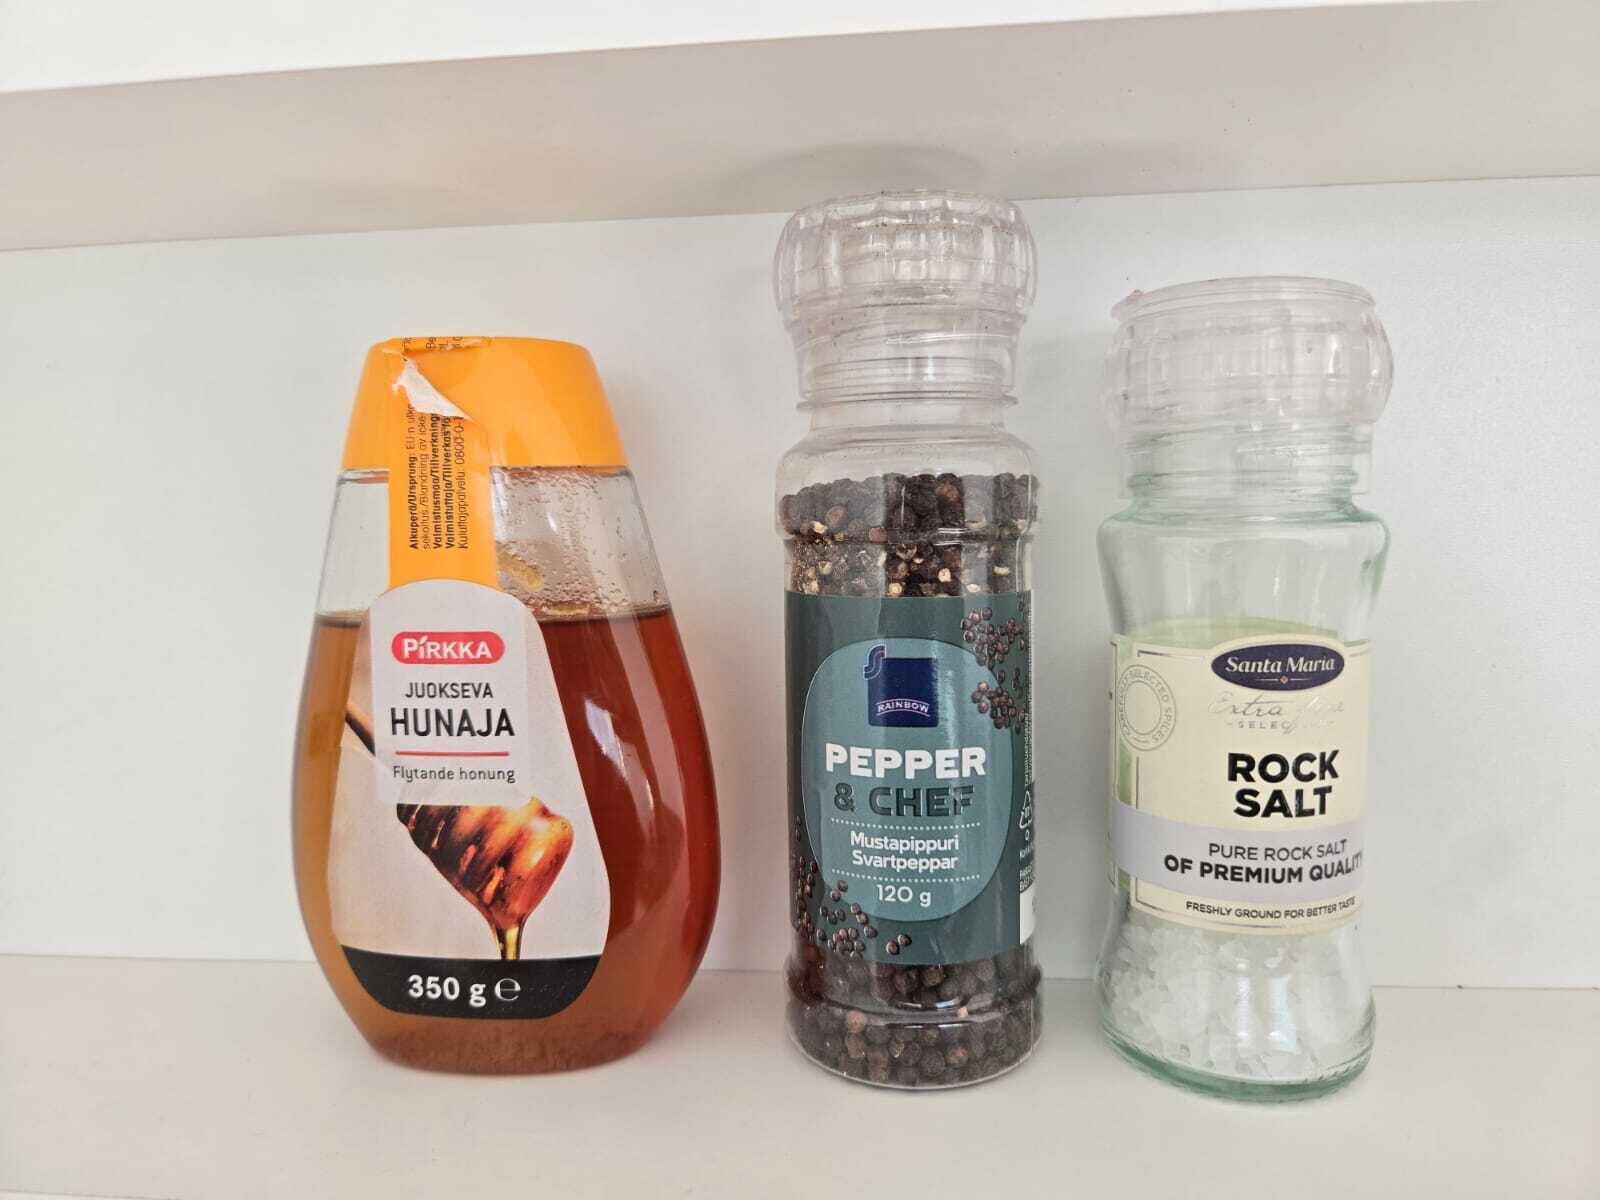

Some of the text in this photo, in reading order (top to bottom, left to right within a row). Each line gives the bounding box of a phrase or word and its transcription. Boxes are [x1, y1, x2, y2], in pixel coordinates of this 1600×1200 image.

[1225, 655, 1335, 673] Santa Maria
[405, 682, 494, 699] JUOKSEVA
[877, 701, 930, 713] RAINBOW
[390, 707, 515, 737] HUNAJA
[825, 743, 986, 779] PEPPER
[1228, 750, 1340, 783] ROCK
[393, 766, 516, 784] Flytande honung
[833, 782, 975, 818] & CHEF
[1233, 786, 1333, 818] SALT
[850, 830, 960, 853] Mustapippuri
[1209, 839, 1347, 861] PURE ROCK SALT
[852, 851, 959, 873] Svartpeppar
[1164, 850, 1362, 884] OF PREMIUM QUALIT
[877, 884, 931, 907] 120 g
[1186, 901, 1232, 916] FRESHLY
[1234, 908, 1282, 919] GROUND
[1284, 908, 1304, 919] FOR
[1306, 904, 1337, 917] BETTER
[408, 974, 460, 1001] 350
[469, 983, 487, 1007] g
